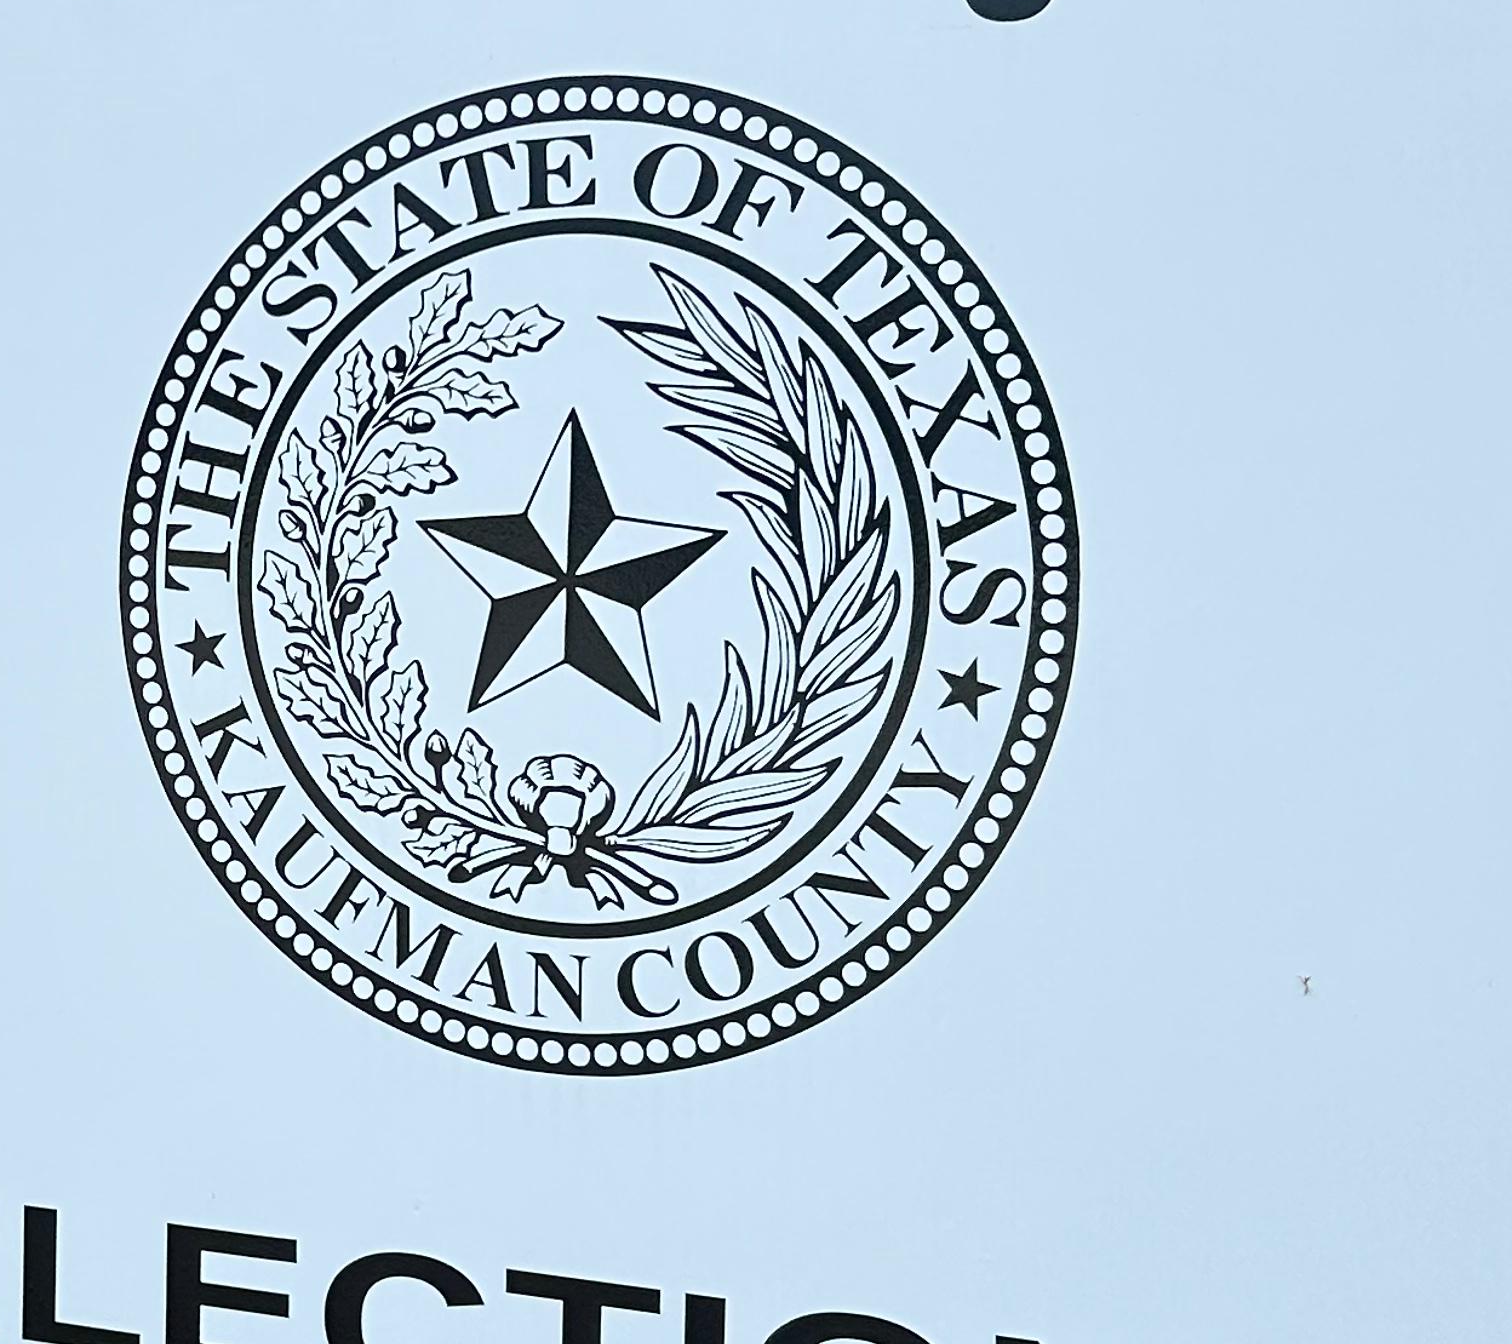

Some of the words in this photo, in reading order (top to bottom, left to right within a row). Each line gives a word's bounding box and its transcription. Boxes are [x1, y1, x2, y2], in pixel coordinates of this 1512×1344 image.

[163, 346, 284, 593] THE
[260, 133, 597, 348] STATE
[632, 142, 806, 243] OF
[802, 217, 1028, 629] TEXAS
[189, 695, 590, 1023] KAUFMAN
[616, 727, 975, 1019] COUNTY
